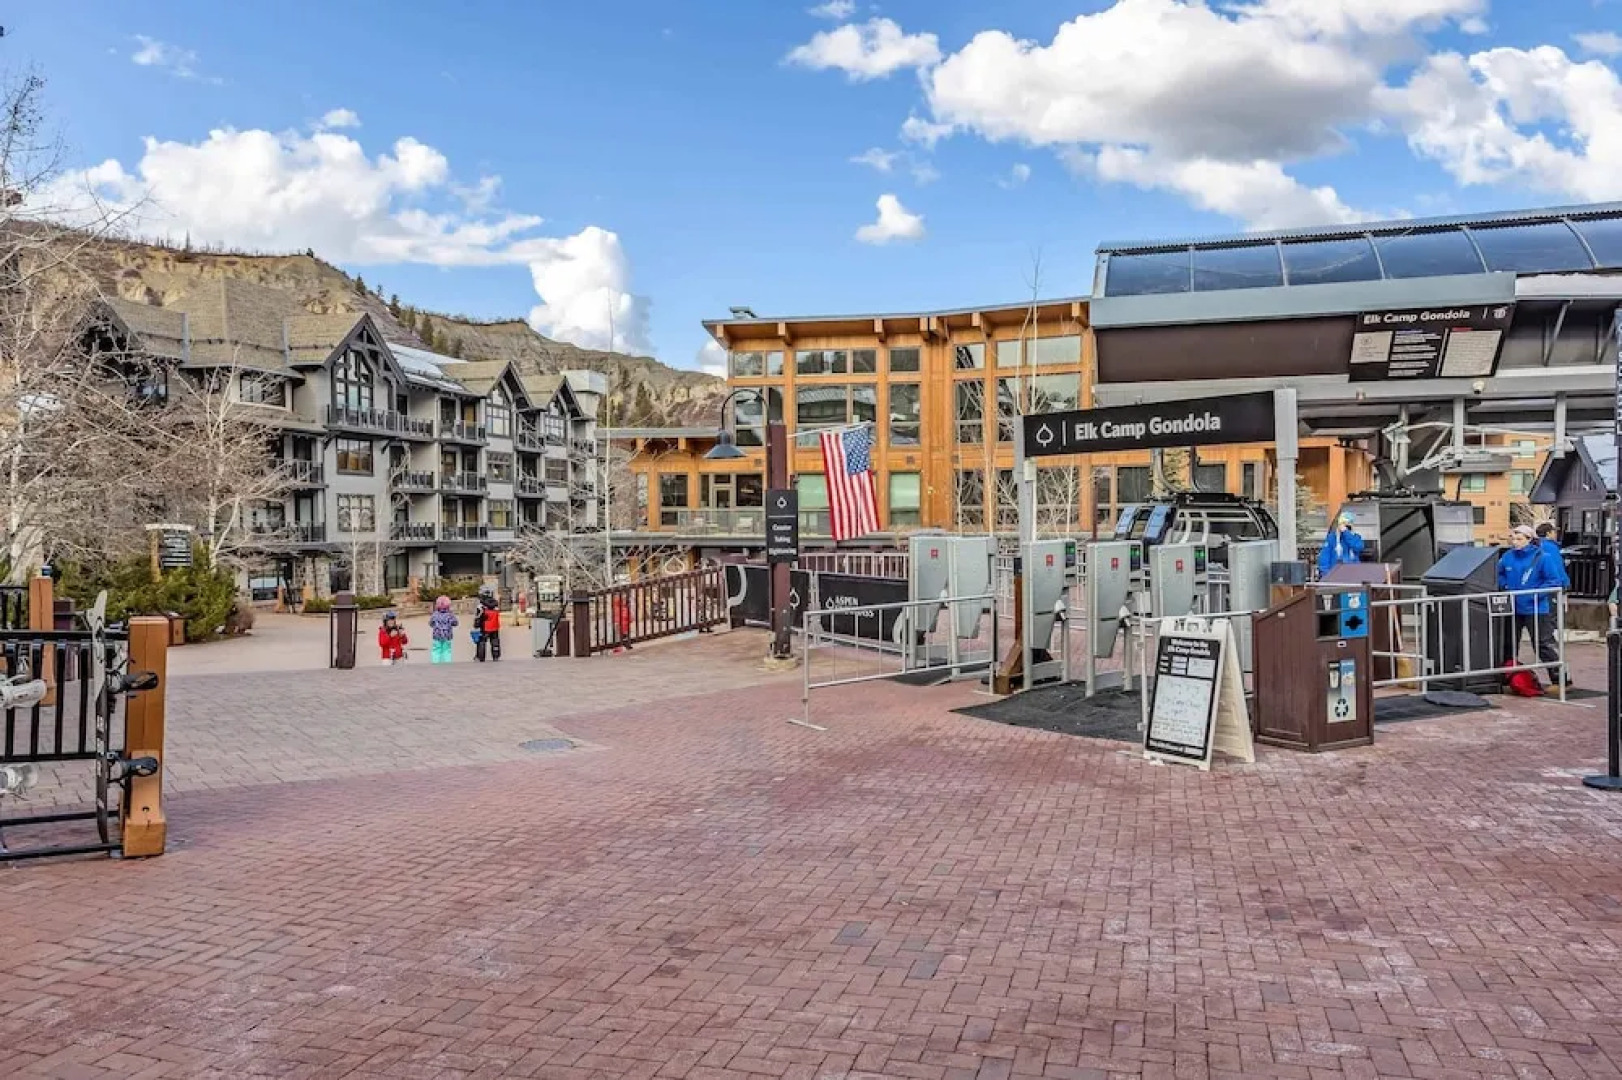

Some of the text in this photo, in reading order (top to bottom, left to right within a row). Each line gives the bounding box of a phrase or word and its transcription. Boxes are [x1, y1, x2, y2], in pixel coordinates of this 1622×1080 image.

[1363, 309, 1471, 325] Elk Camp Gondola
[1075, 411, 1221, 441] Elk Camp Gondola
[835, 595, 859, 606] ASPEN
